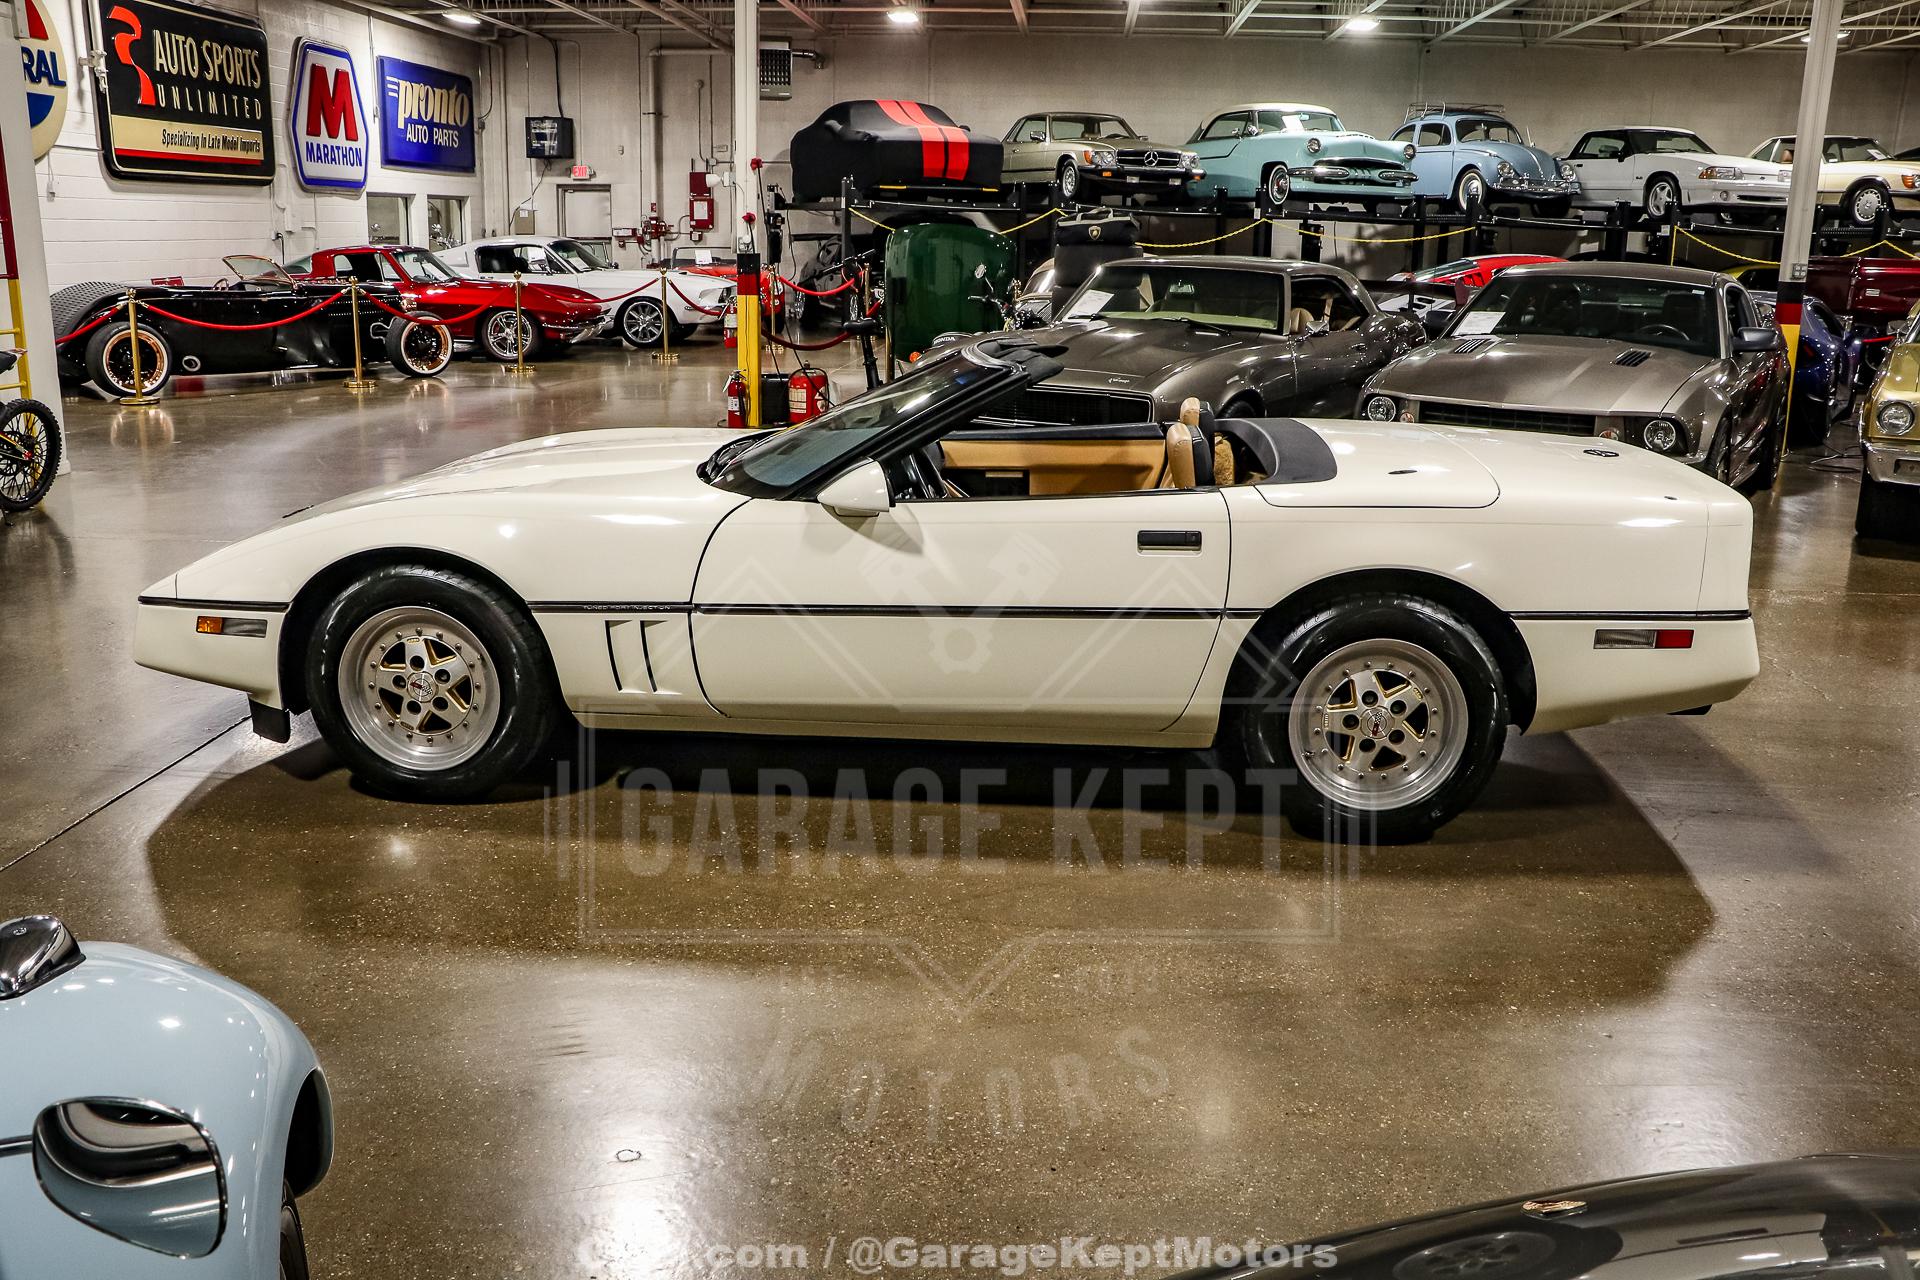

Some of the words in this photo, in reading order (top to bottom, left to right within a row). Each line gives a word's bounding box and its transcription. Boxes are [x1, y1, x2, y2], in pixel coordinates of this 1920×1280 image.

[153, 29, 199, 79] AUTO
[202, 39, 262, 90] SPORTS
[156, 84, 262, 120] UNLIMITED
[306, 63, 359, 142] M
[397, 79, 469, 130] pronto
[162, 128, 200, 151] Specializing
[201, 133, 207, 149] In
[208, 134, 221, 150] Late
[222, 136, 239, 152] Model
[406, 126, 429, 145] AUTO
[433, 128, 460, 149] PARTS
[305, 141, 363, 168] MARATHON
[573, 165, 589, 177] EXIT
